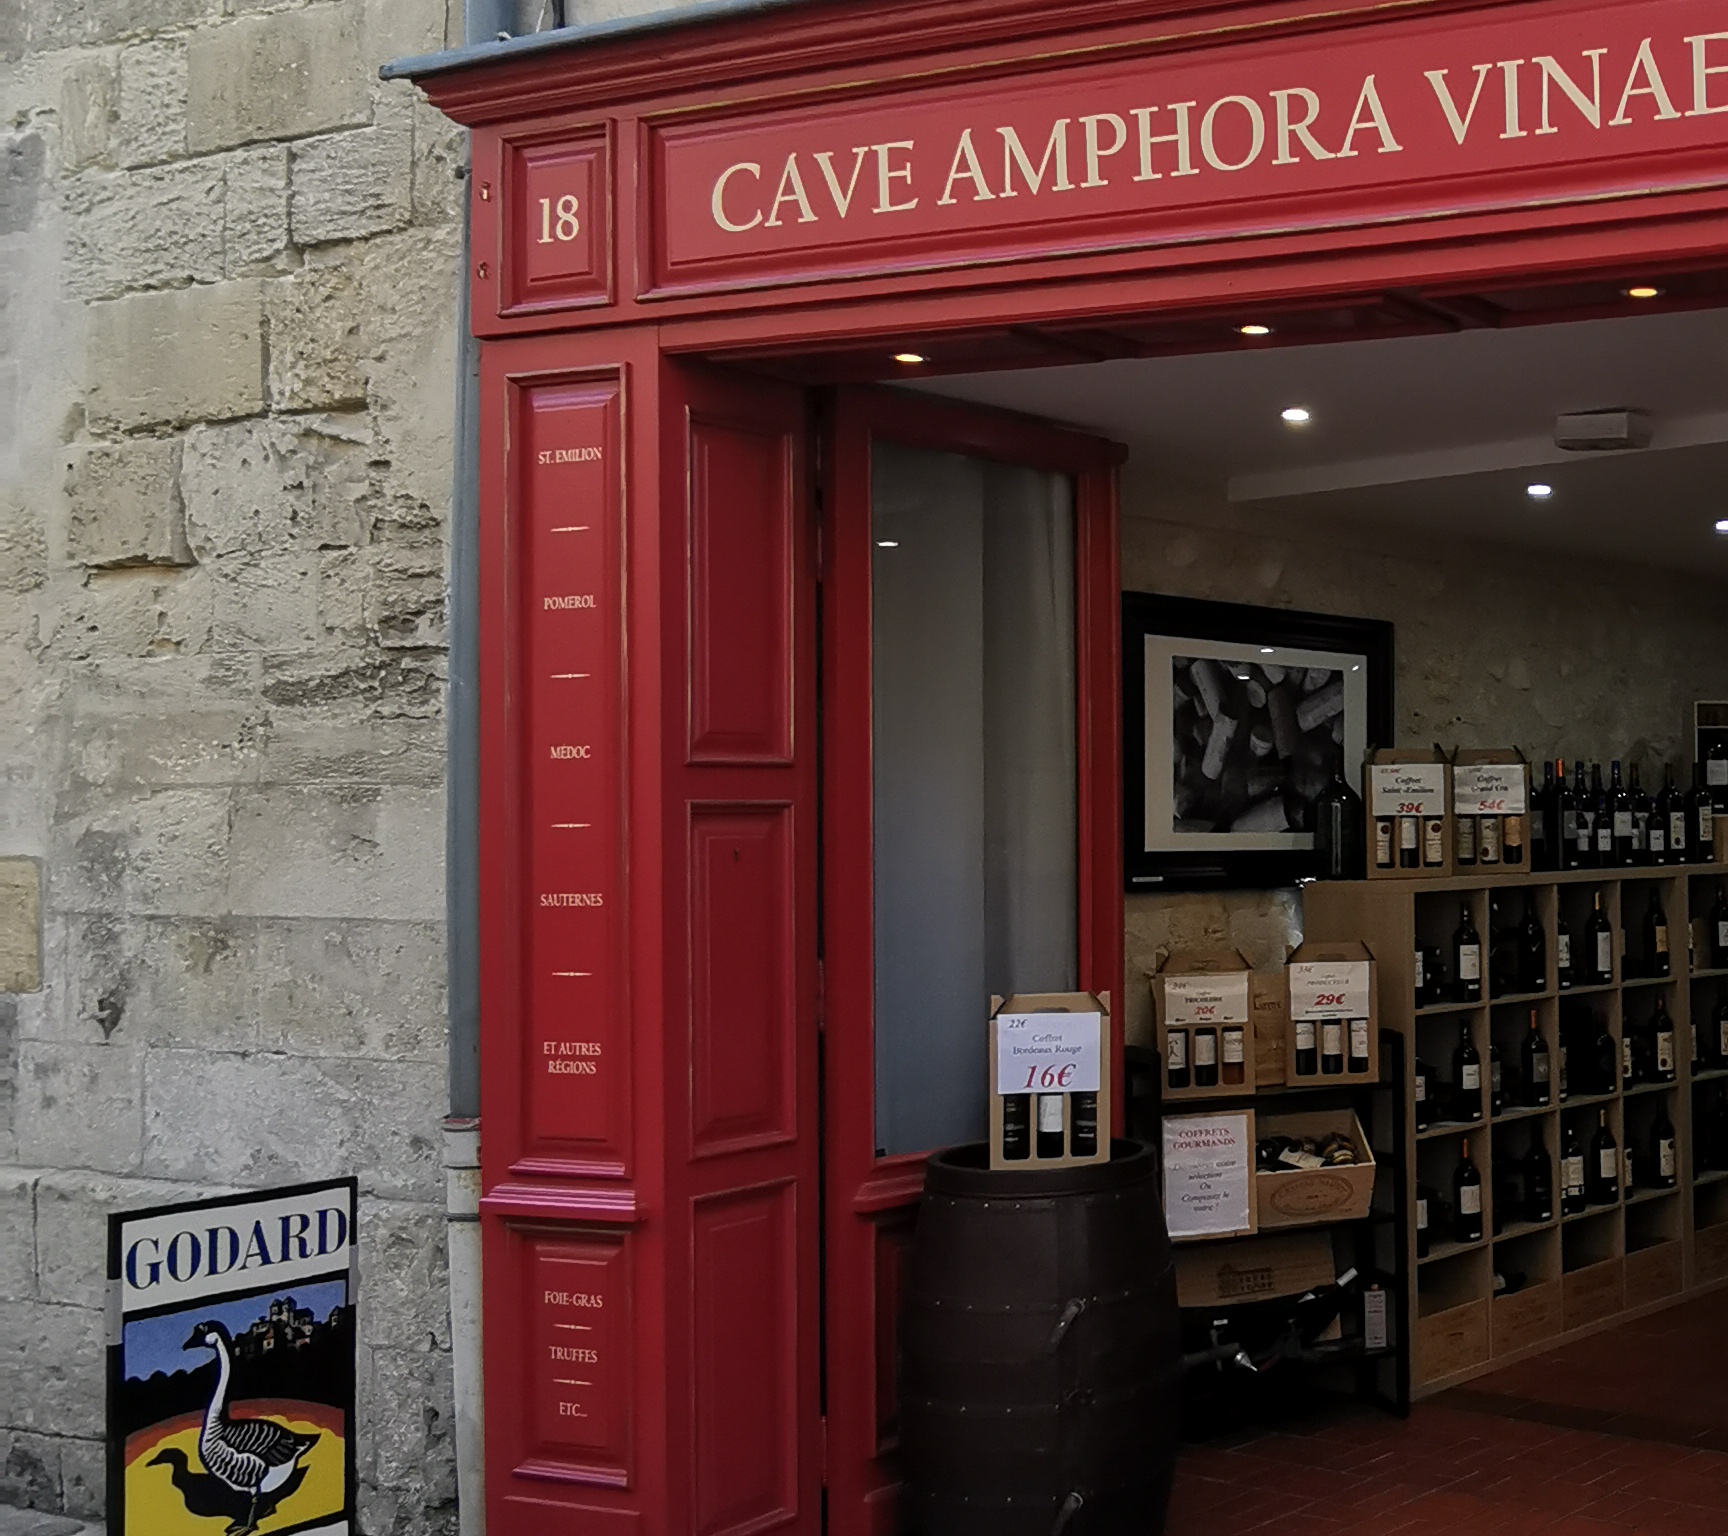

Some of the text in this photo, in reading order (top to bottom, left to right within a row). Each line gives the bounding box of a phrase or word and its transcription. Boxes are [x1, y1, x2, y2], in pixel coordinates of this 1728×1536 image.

[711, 140, 919, 232] CAVE
[937, 74, 1404, 205] AMPHORA
[537, 193, 580, 243] 18
[556, 447, 602, 463] EMILION
[543, 594, 597, 611] POMEROL
[550, 743, 591, 760] MÉDOC
[1395, 802, 1424, 814] 39€
[540, 893, 604, 907] SAUTERNES
[1314, 993, 1346, 1006] 29€
[1008, 1019, 1028, 1029] 22€
[543, 1041, 602, 1056] ET AUTRES
[1054, 1044, 1082, 1055] Rouge
[547, 1060, 597, 1074] RÉGIONS
[1023, 1063, 1077, 1089] 16€
[1178, 1127, 1230, 1139] COFFRETS
[1172, 1138, 1236, 1150] GOURMANDS
[125, 1207, 347, 1291] GODARD
[544, 1290, 603, 1308] FOIE-GRAS
[548, 1345, 598, 1364] TRUFFES
